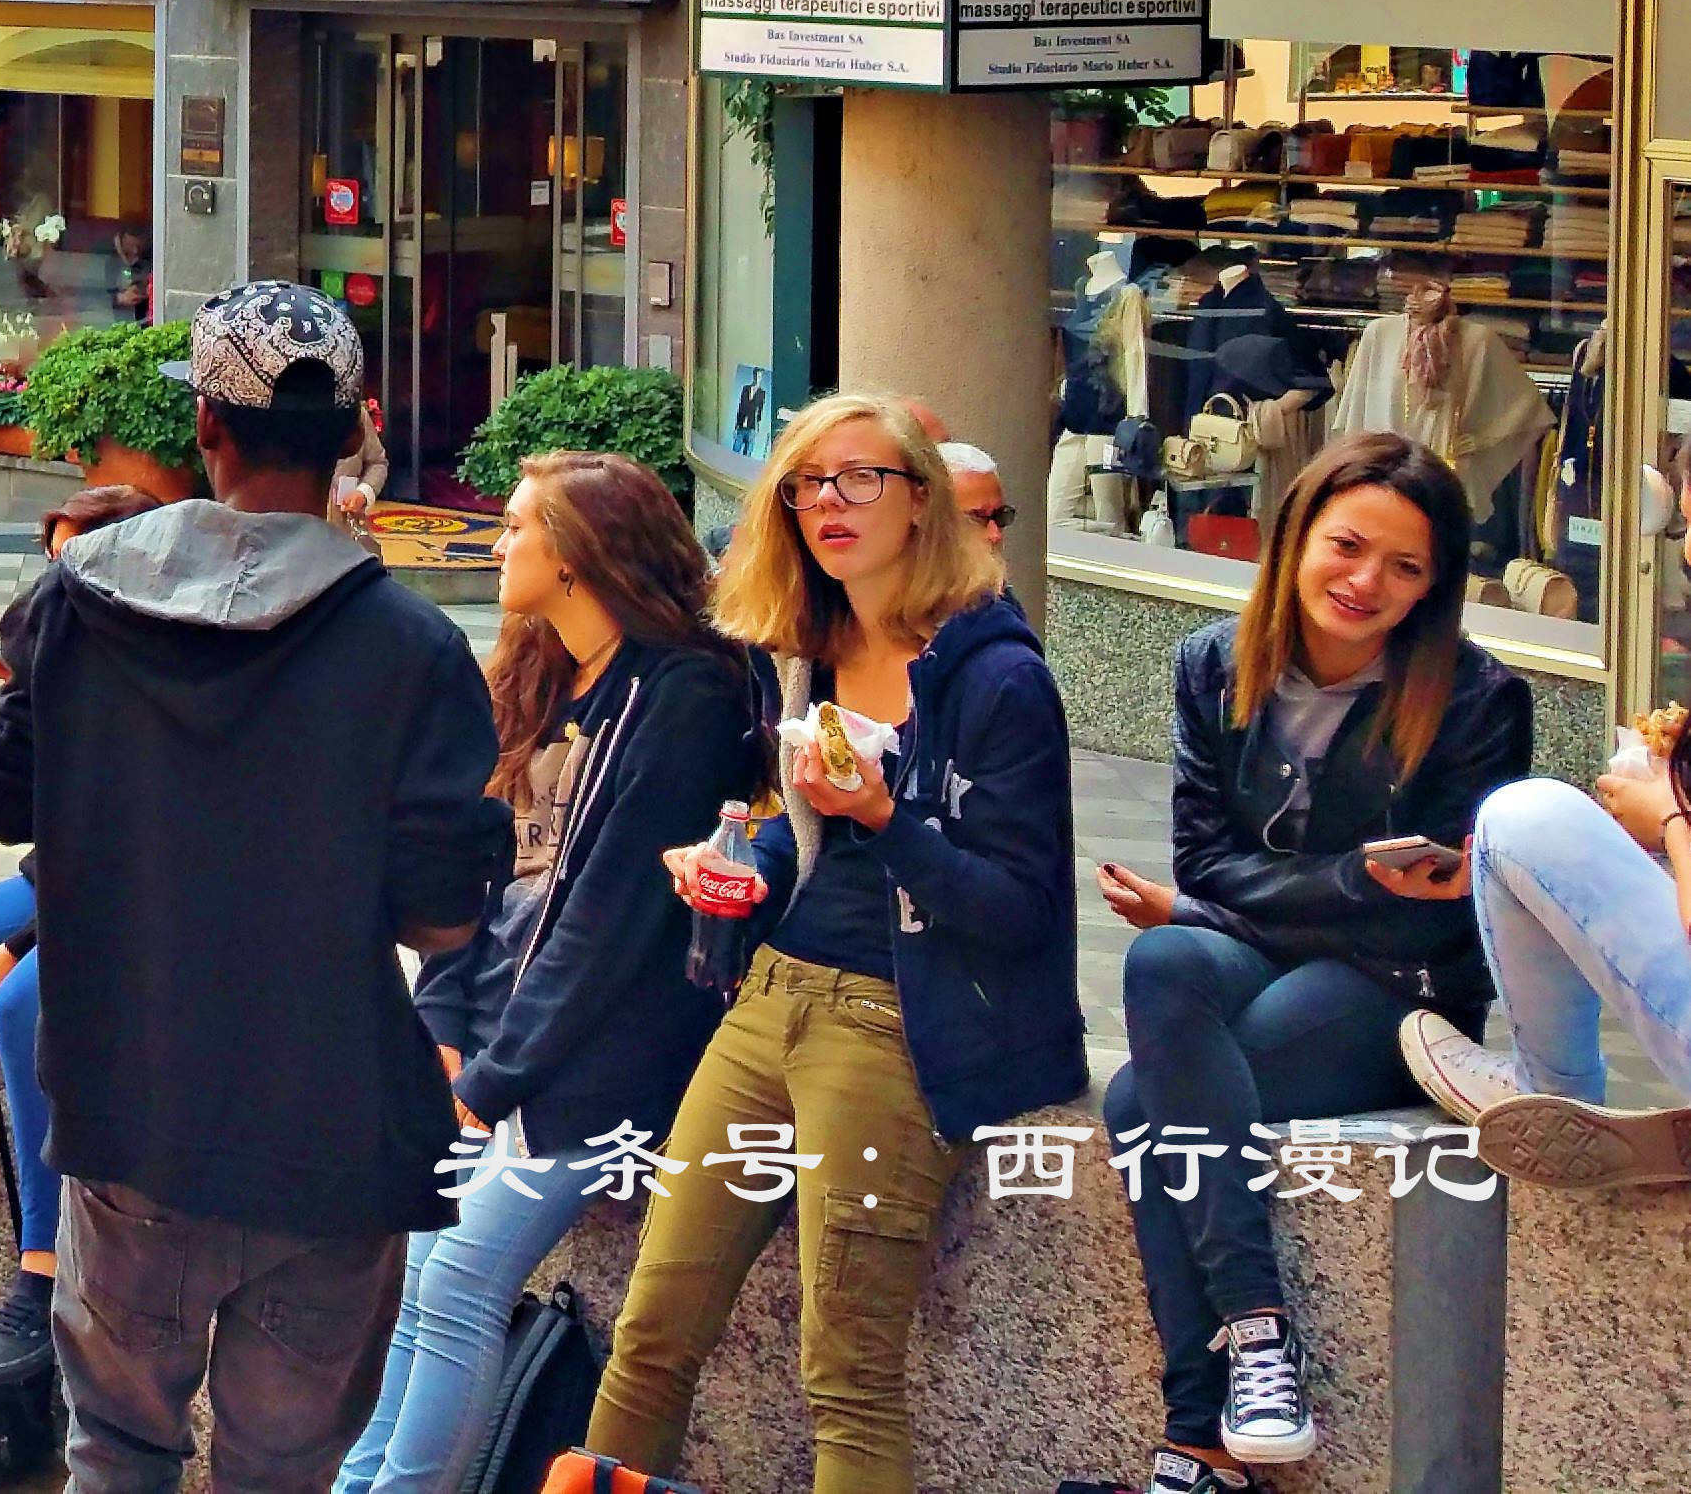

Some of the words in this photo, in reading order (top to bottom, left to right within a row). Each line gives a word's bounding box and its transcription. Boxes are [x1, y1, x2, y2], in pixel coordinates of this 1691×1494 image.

[877, 0, 941, 20] sportivi
[1040, 0, 1123, 20] terapeutici
[788, 29, 844, 44] Investment
